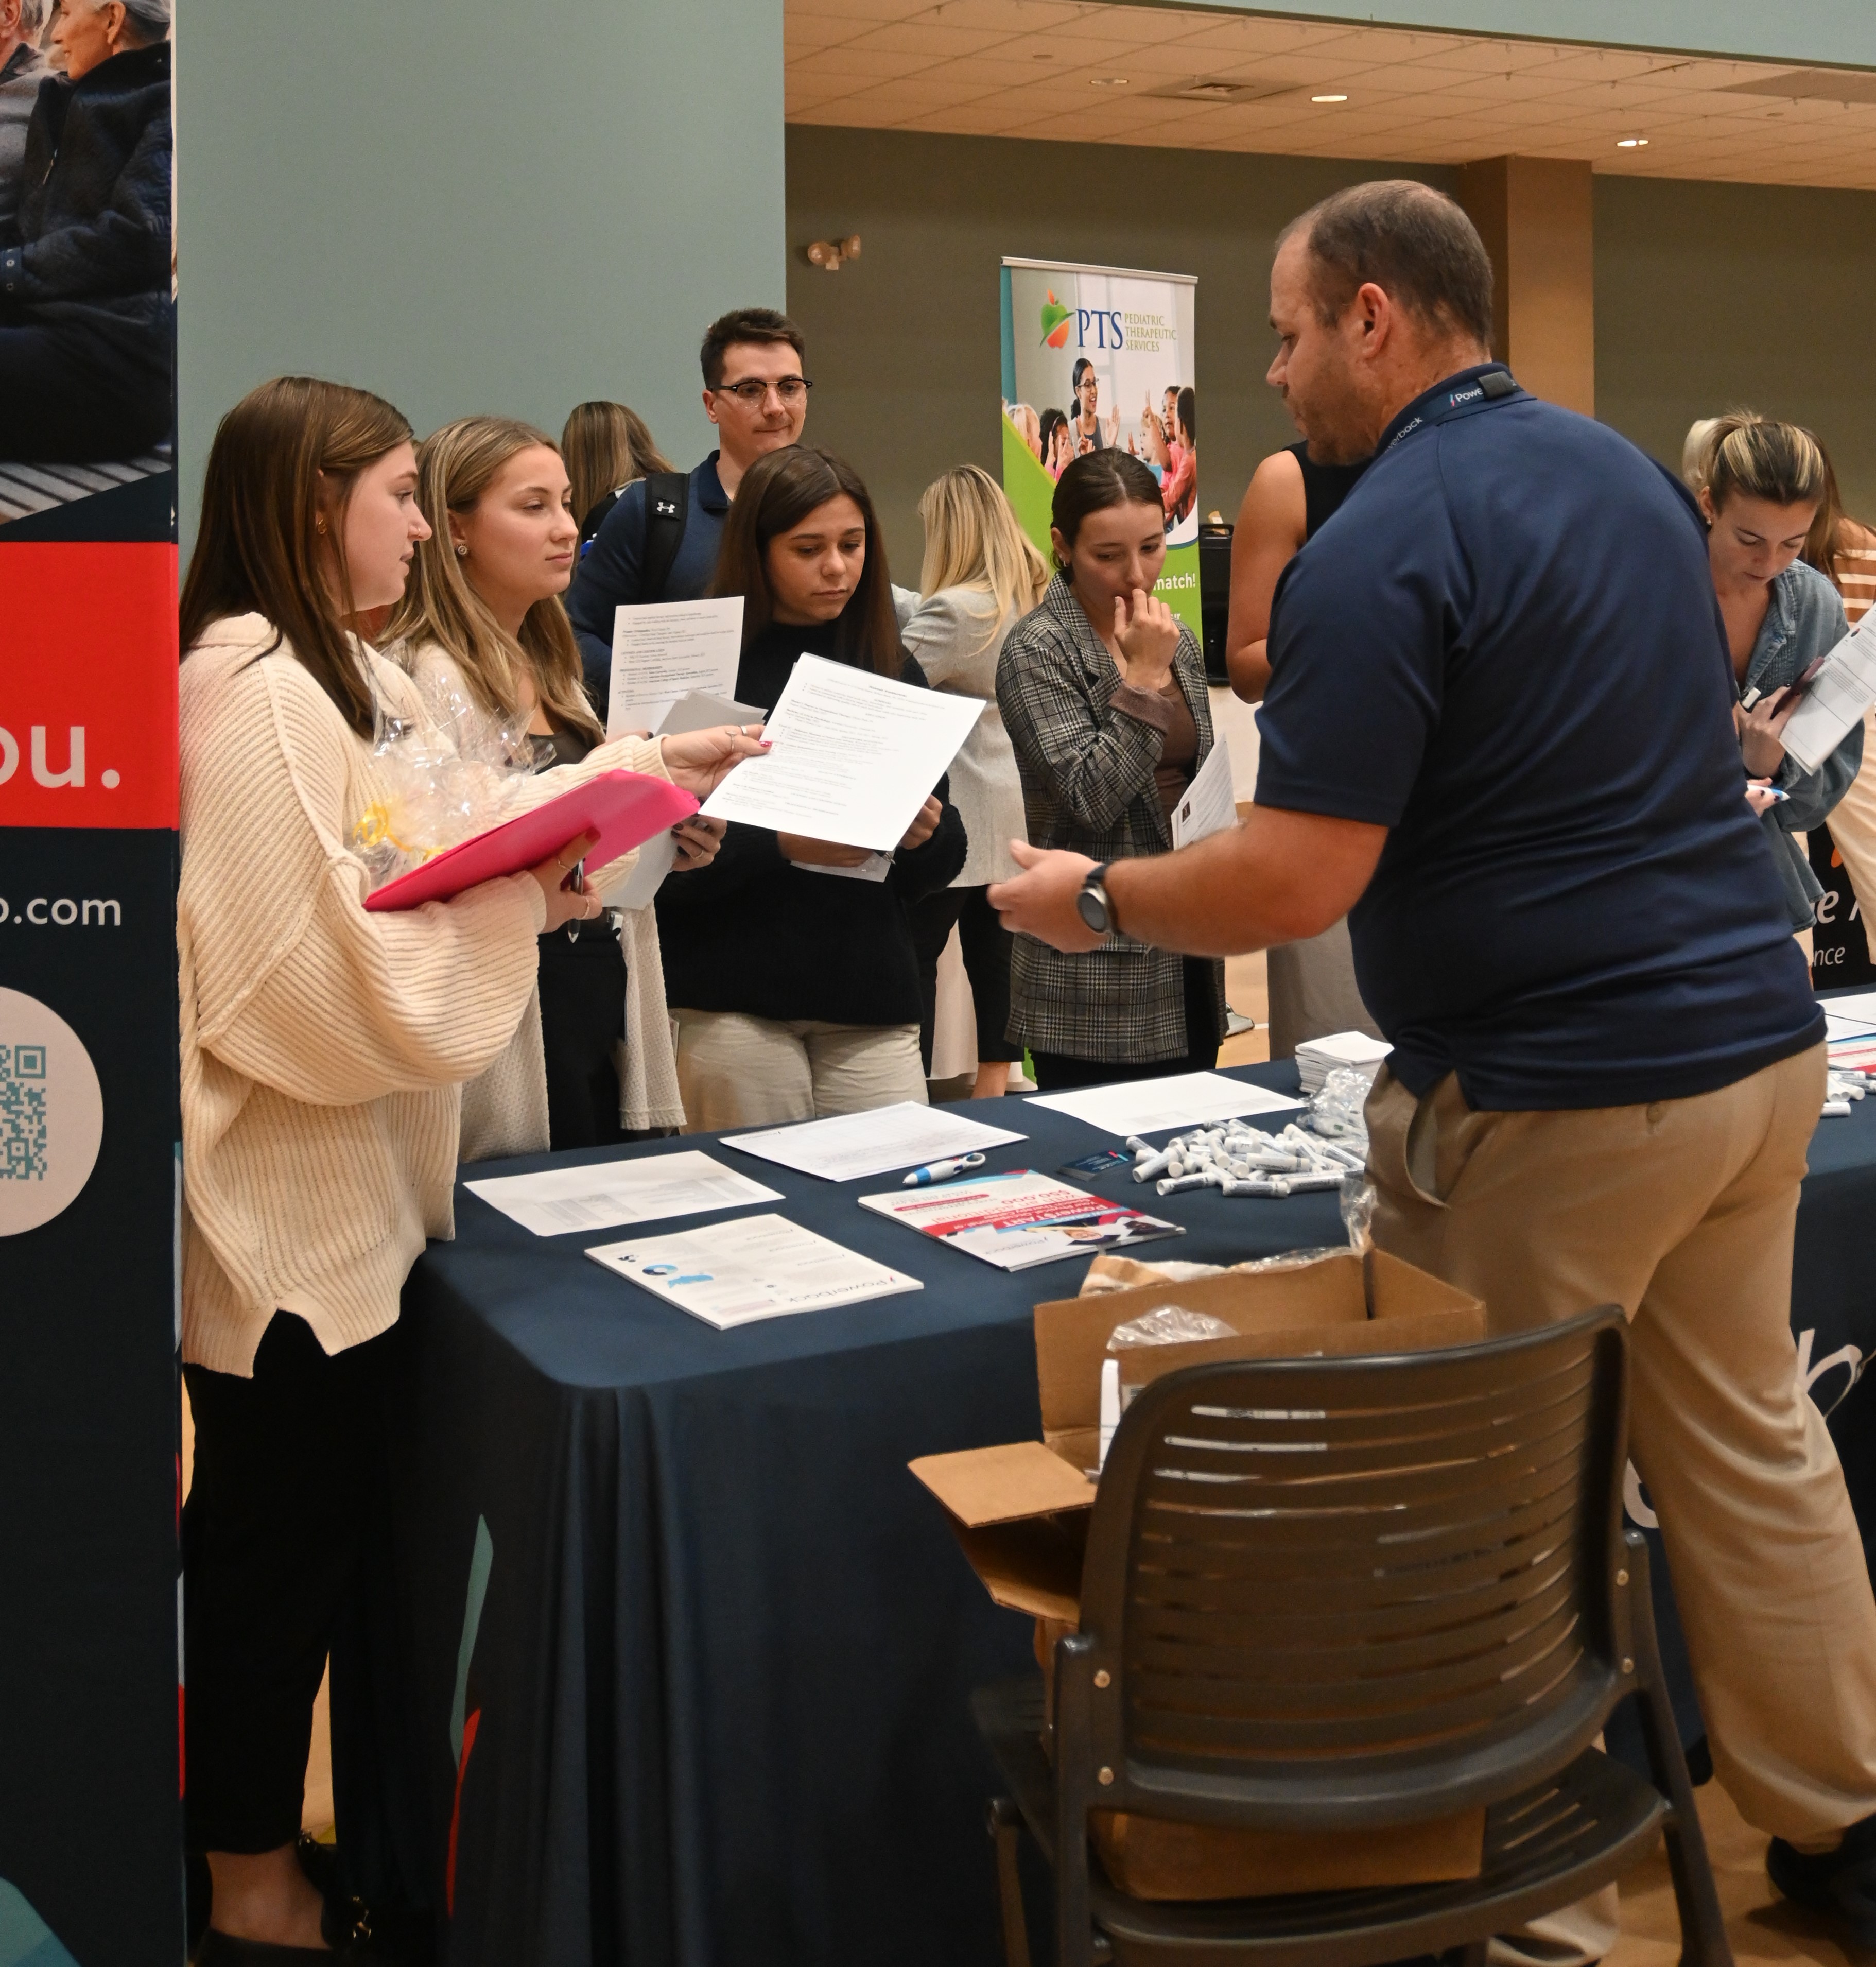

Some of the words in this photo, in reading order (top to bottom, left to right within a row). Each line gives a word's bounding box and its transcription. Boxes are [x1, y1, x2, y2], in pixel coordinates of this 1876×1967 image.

[1124, 313, 1165, 326] PEDIATRIC
[1076, 309, 1123, 350] PTS
[1124, 326, 1177, 340] THERAPEUTIC
[1126, 340, 1159, 352] SERVICES
[1000, 1190, 1070, 1205] $50,000
[786, 1280, 887, 1303] Powerback
